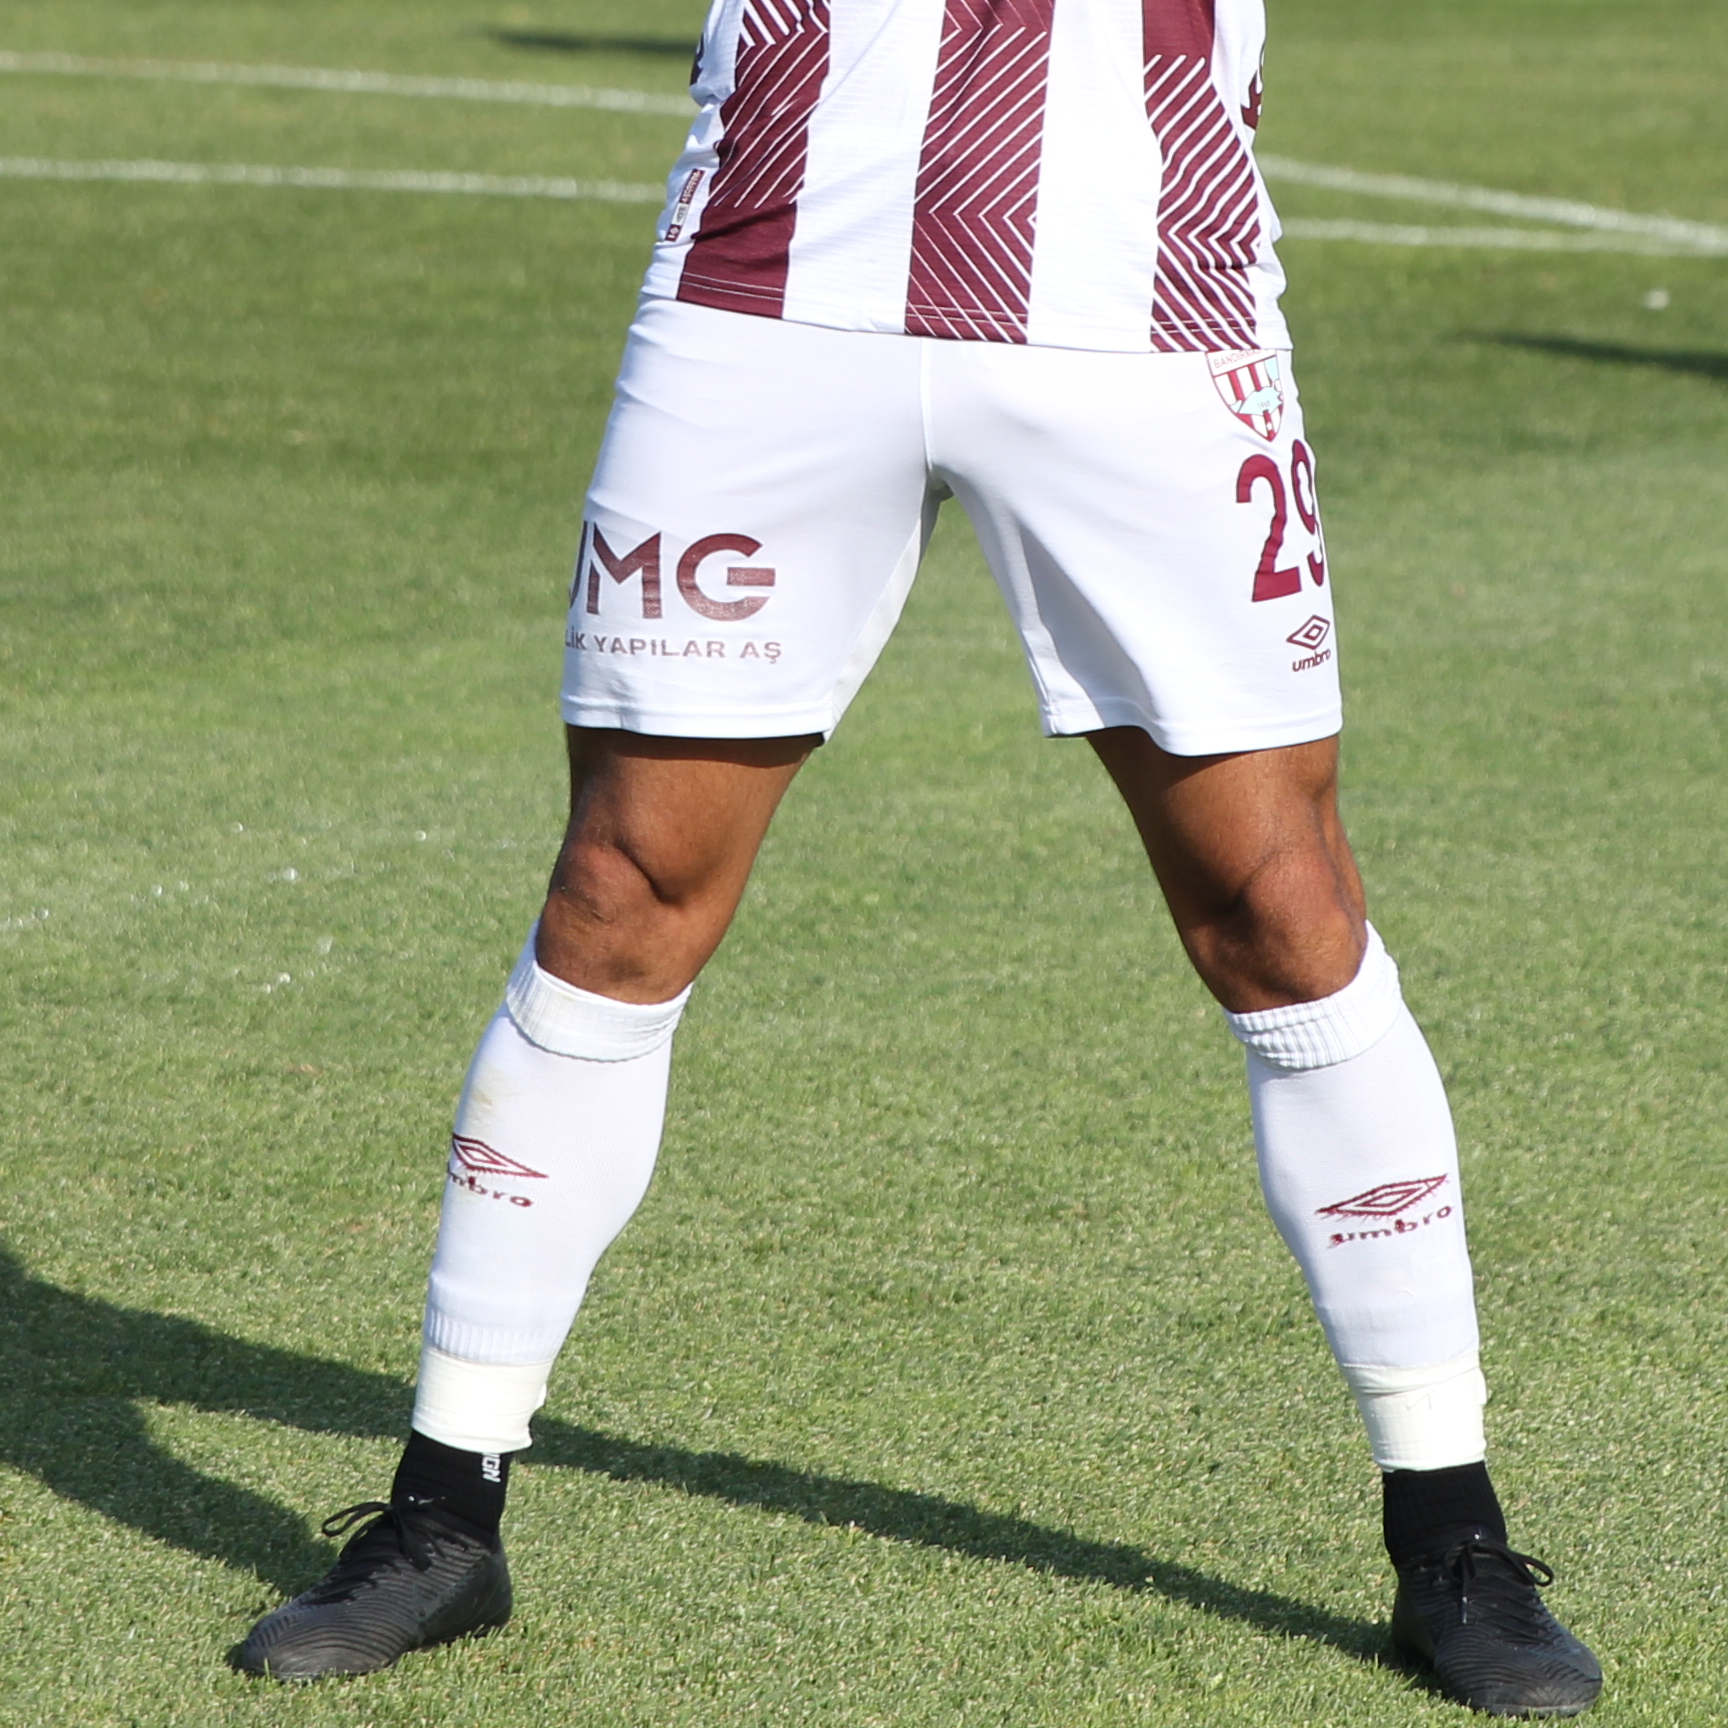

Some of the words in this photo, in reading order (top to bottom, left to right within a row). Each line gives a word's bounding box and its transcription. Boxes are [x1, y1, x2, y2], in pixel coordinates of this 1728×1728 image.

[1236, 439, 1325, 602] 29
[594, 633, 726, 659] YAPILAR
[739, 641, 783, 665] AŞ
[1329, 1205, 1453, 1248] umbro
